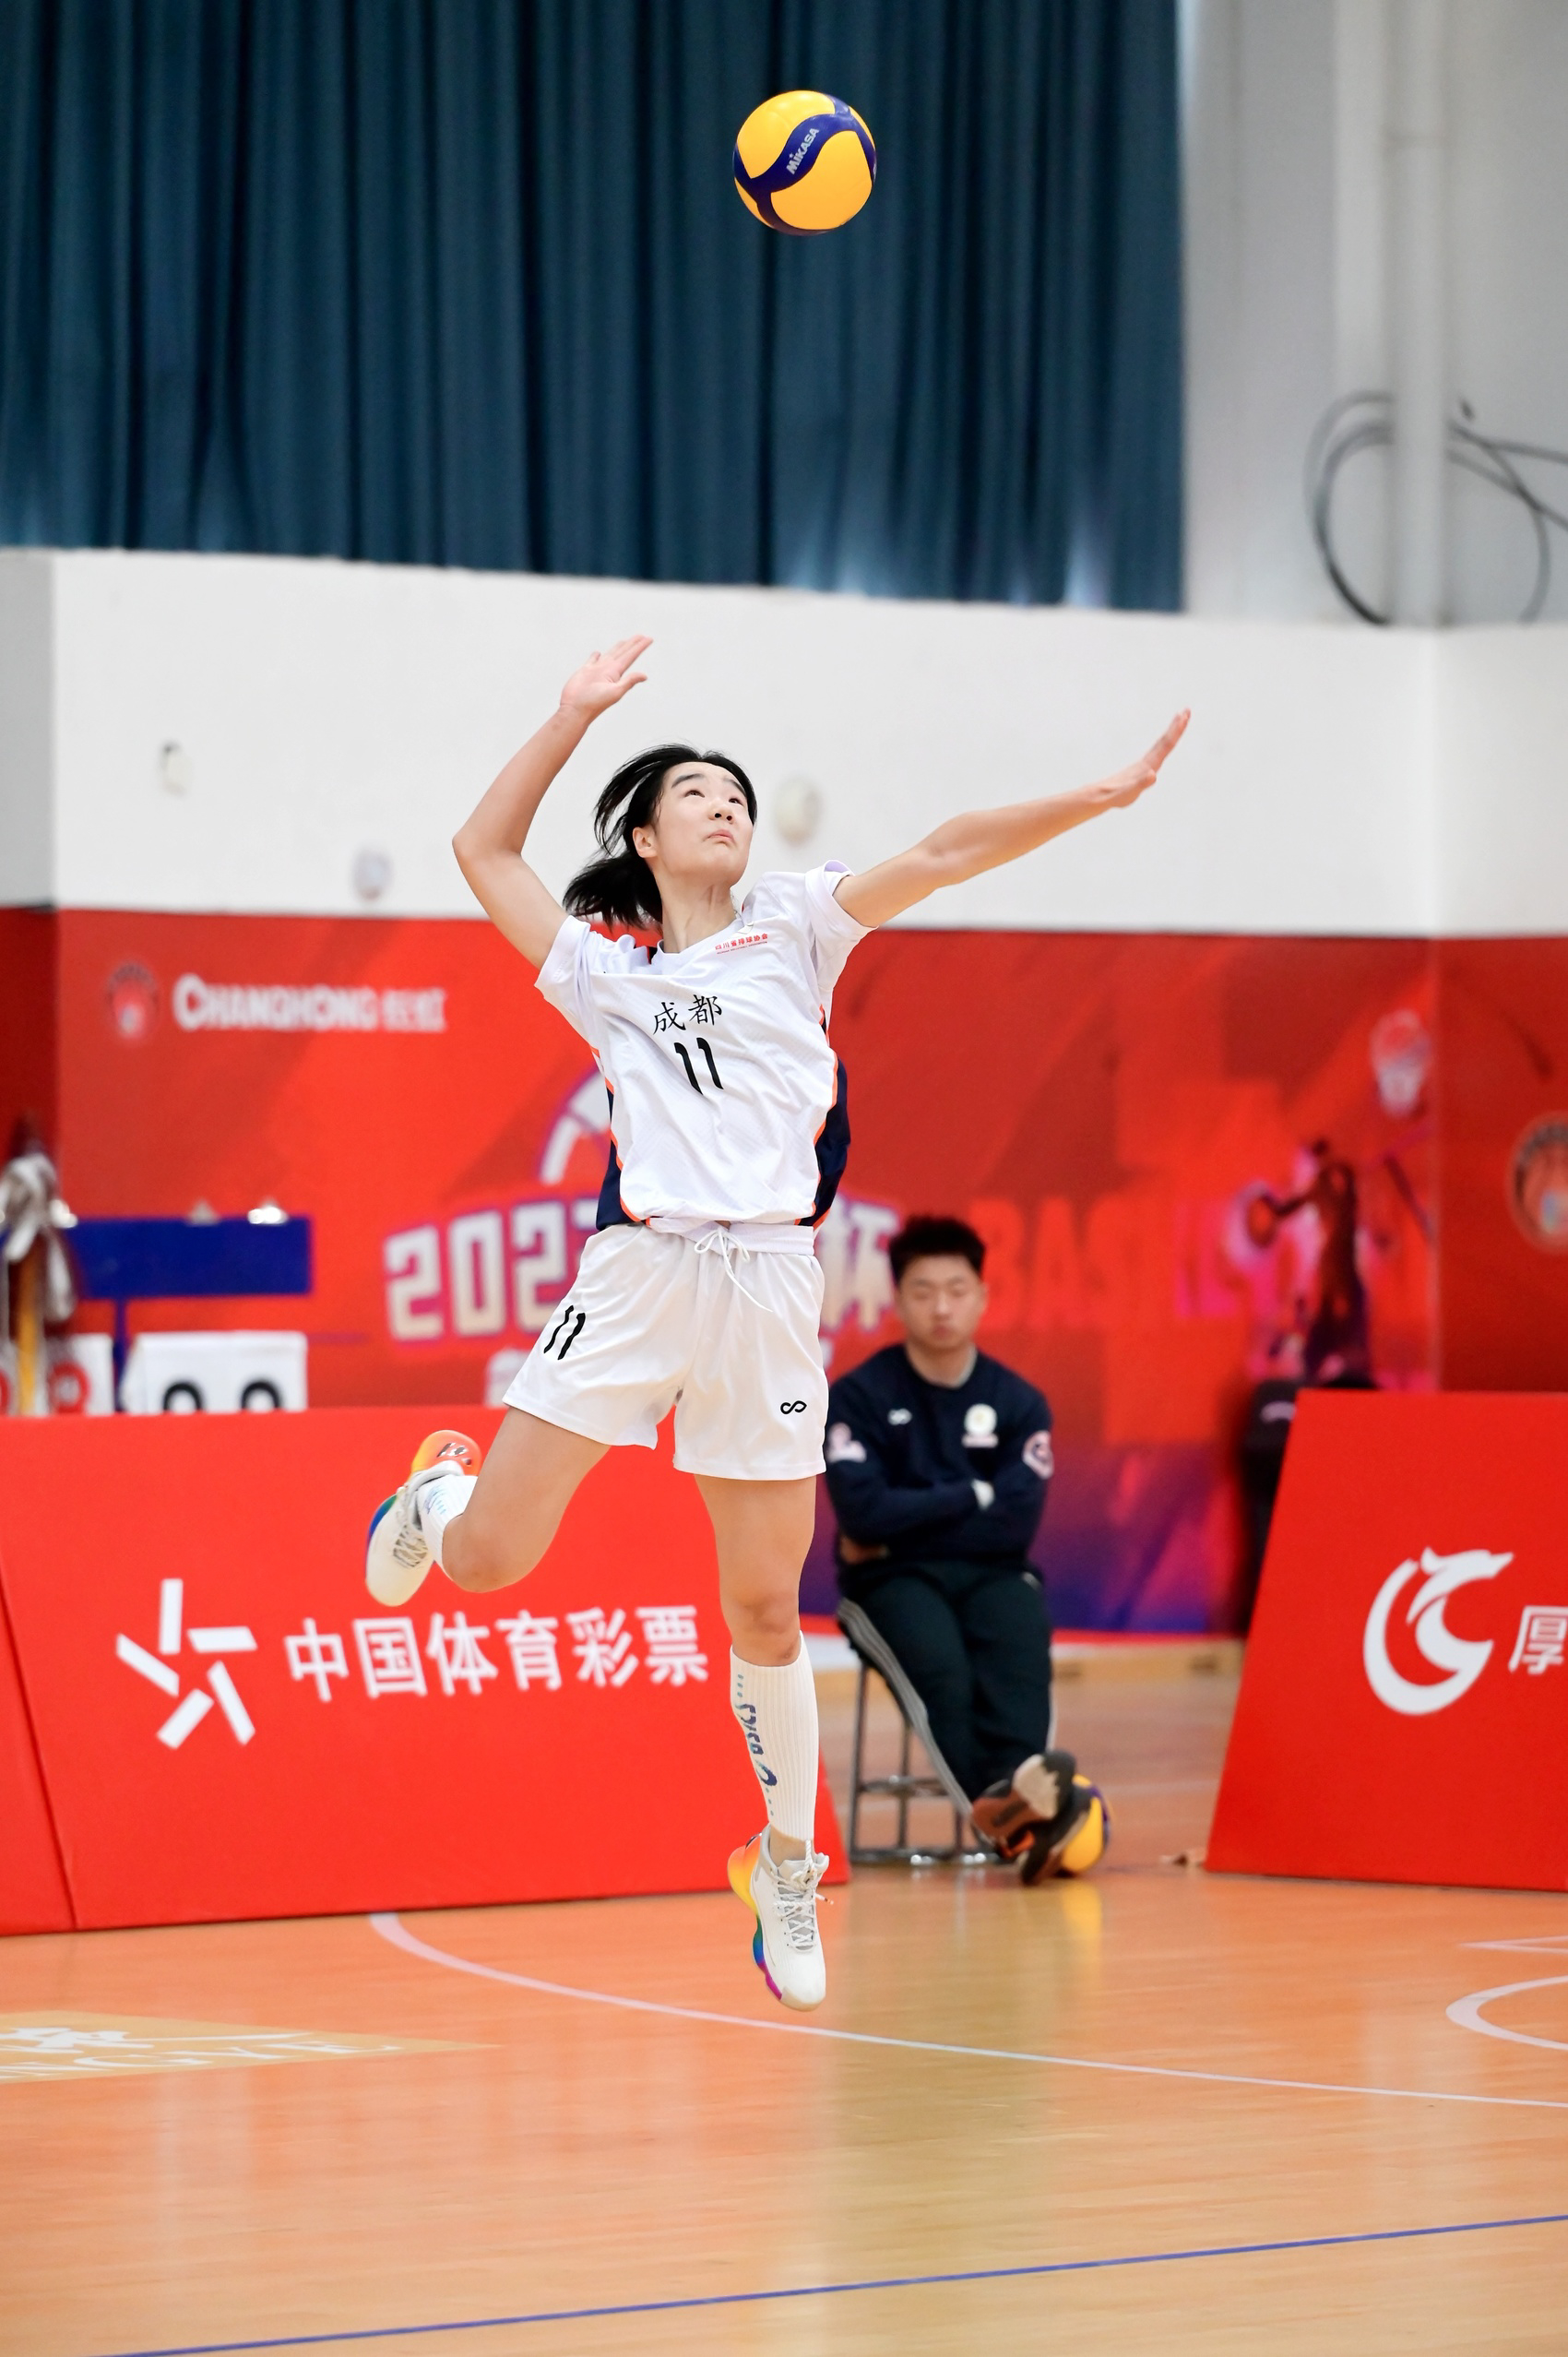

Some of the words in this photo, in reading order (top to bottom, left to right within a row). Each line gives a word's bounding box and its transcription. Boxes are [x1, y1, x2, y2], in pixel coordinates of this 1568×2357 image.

[653, 994, 723, 1035] 成都
[673, 1037, 724, 1096] 11
[543, 1304, 586, 1361] 11
[283, 1604, 709, 1704] 中国体育彩票
[1508, 1605, 1568, 1675] 厚
